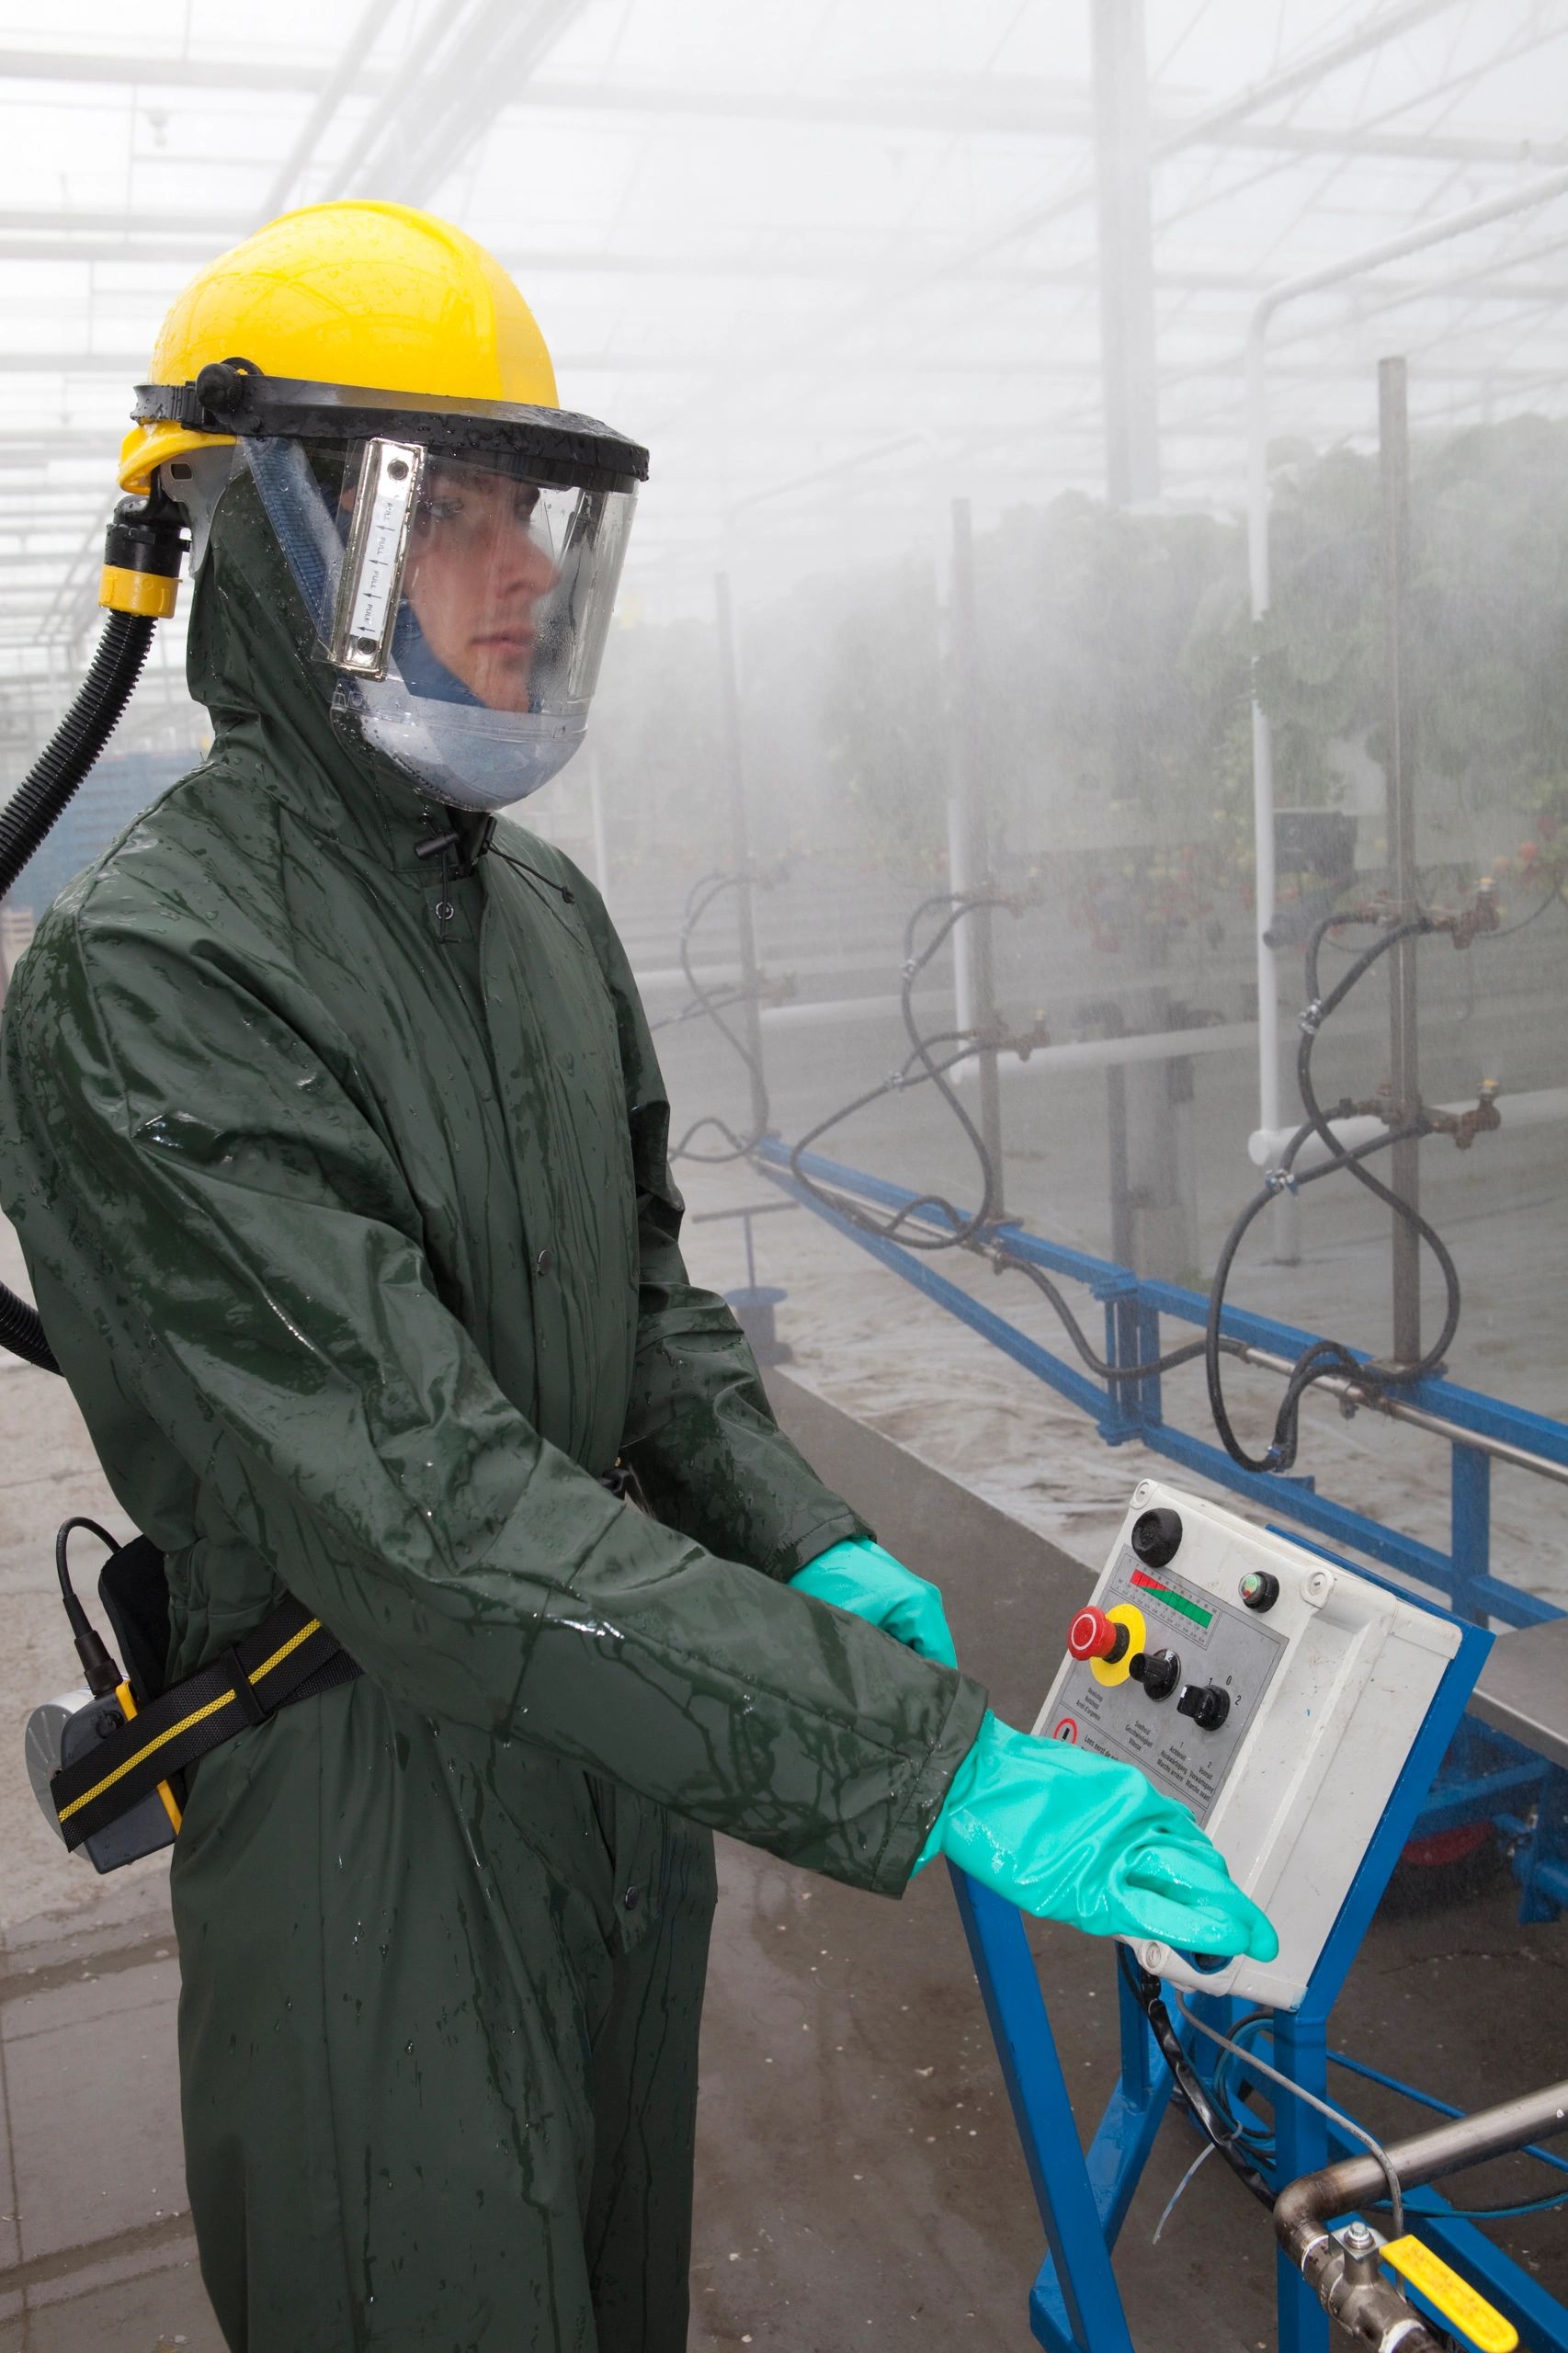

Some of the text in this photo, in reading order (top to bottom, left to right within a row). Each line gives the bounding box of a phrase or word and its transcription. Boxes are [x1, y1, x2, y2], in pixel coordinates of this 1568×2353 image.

[377, 537, 386, 555] PULL
[370, 571, 380, 589] PULL
[1208, 1677, 1213, 1686] 1
[1225, 1675, 1233, 1686] 0
[1234, 1695, 1242, 1706] 2
[1085, 1734, 1095, 1747] Lees
